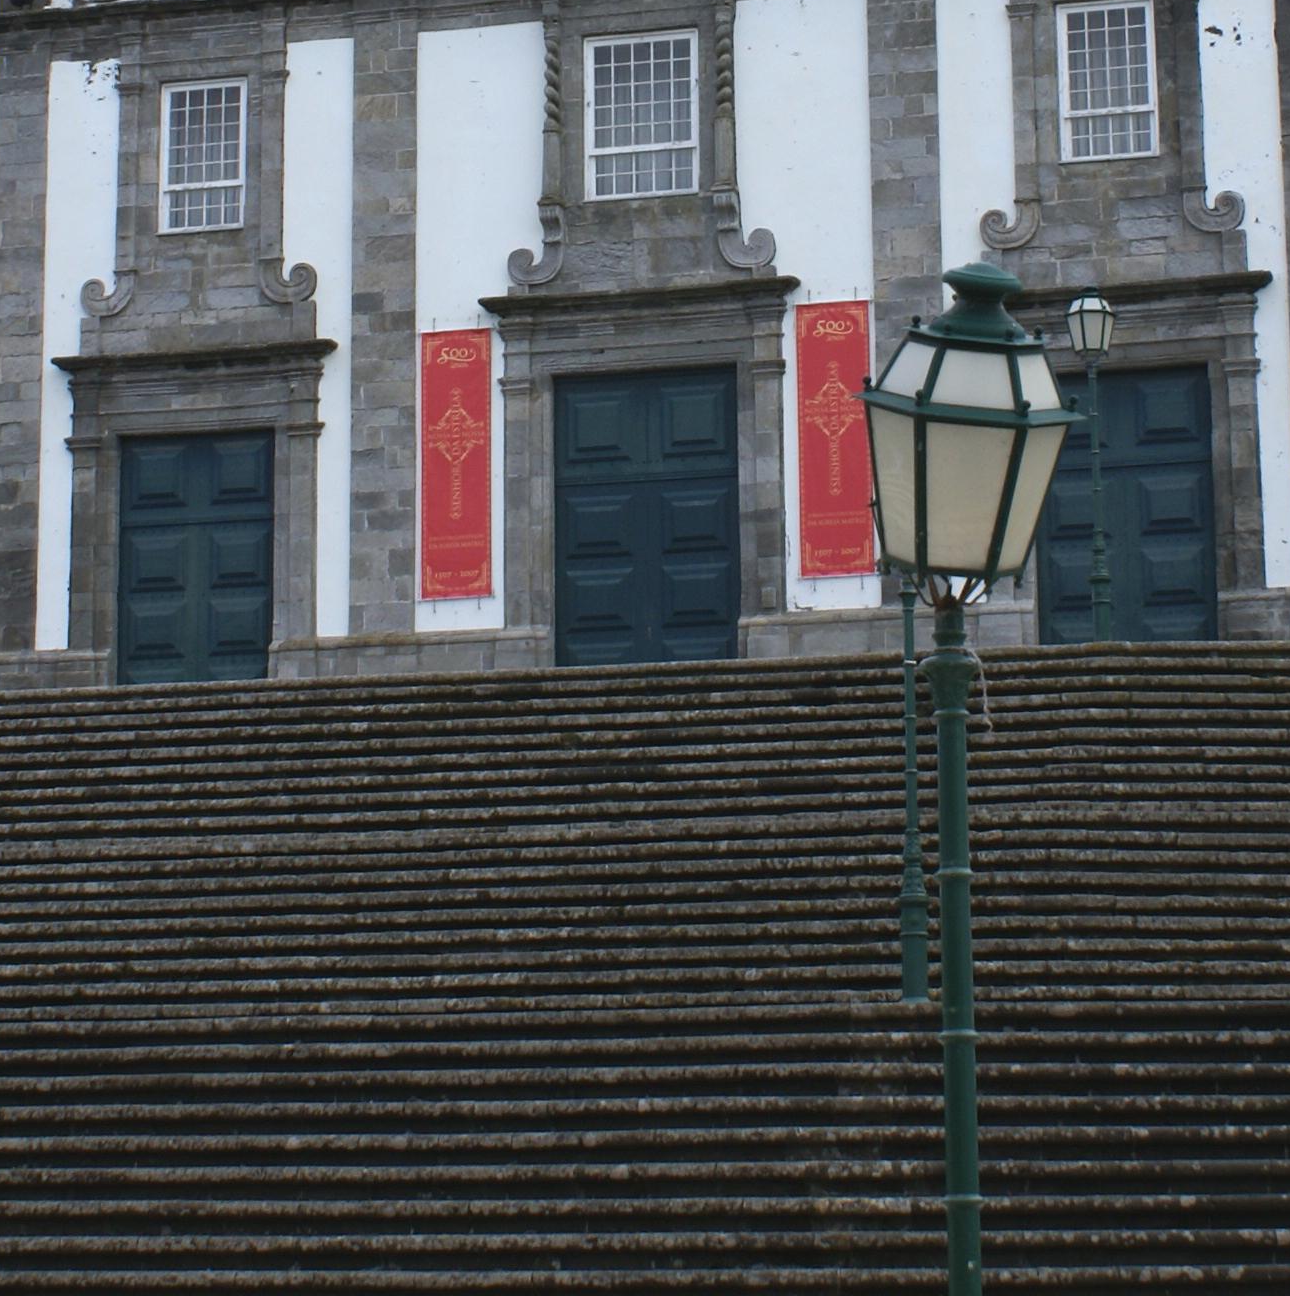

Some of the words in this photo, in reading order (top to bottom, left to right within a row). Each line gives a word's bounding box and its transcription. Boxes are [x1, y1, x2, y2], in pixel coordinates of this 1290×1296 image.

[828, 368, 838, 413] ESTRELA
[452, 394, 461, 438] ESTRELA
[829, 414, 839, 431] DA
[452, 440, 461, 456] DA
[829, 435, 840, 488] SENHORA
[452, 459, 461, 512] SENHORA
